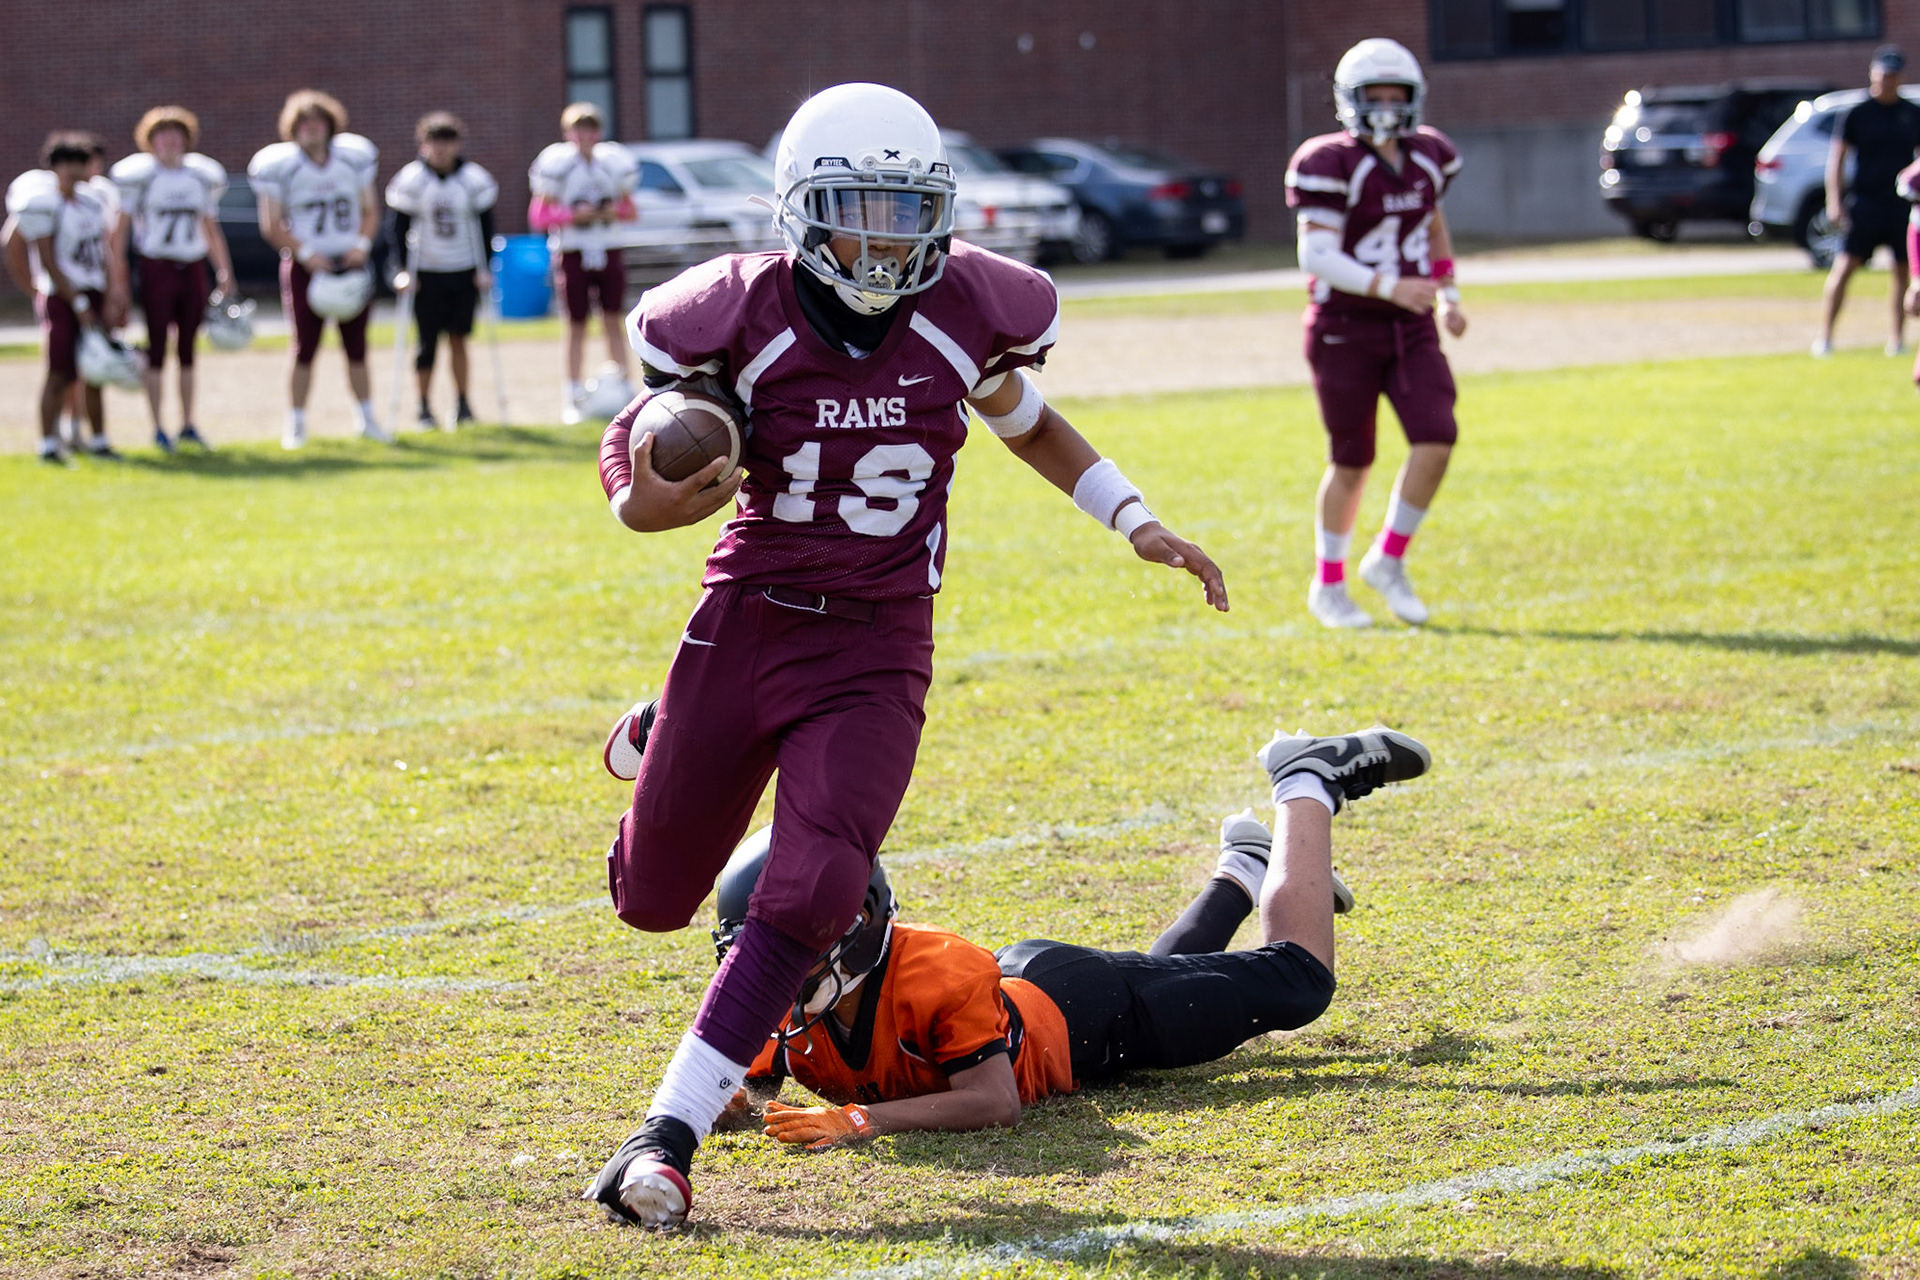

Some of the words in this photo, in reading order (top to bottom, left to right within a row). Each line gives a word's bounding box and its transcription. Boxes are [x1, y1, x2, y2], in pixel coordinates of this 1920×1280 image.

[158, 207, 198, 244] 77
[304, 195, 352, 235] 78
[1355, 213, 1431, 276] 44
[815, 397, 907, 429] RAMS
